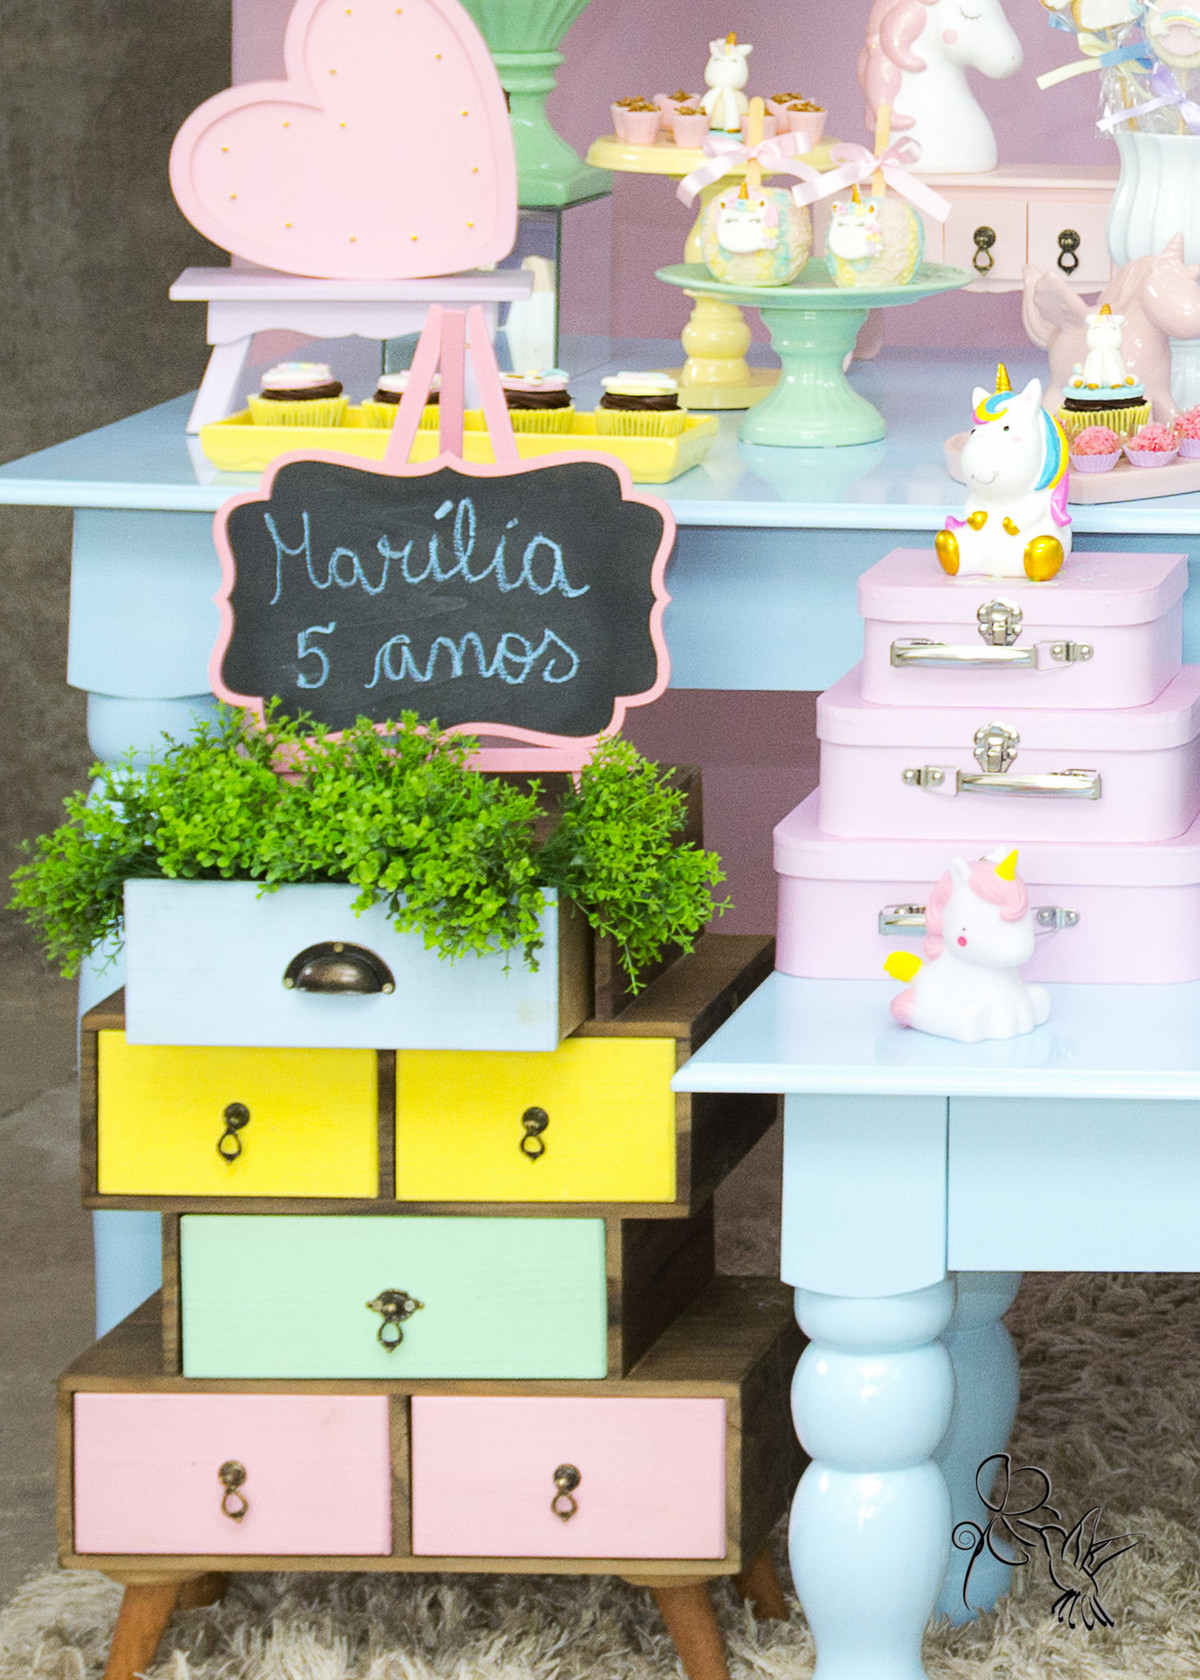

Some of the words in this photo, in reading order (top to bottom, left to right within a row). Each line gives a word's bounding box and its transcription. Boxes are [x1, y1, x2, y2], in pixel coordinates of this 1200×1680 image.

[264, 497, 591, 605] Marília
[296, 621, 336, 689] 5
[364, 627, 580, 689] anos
